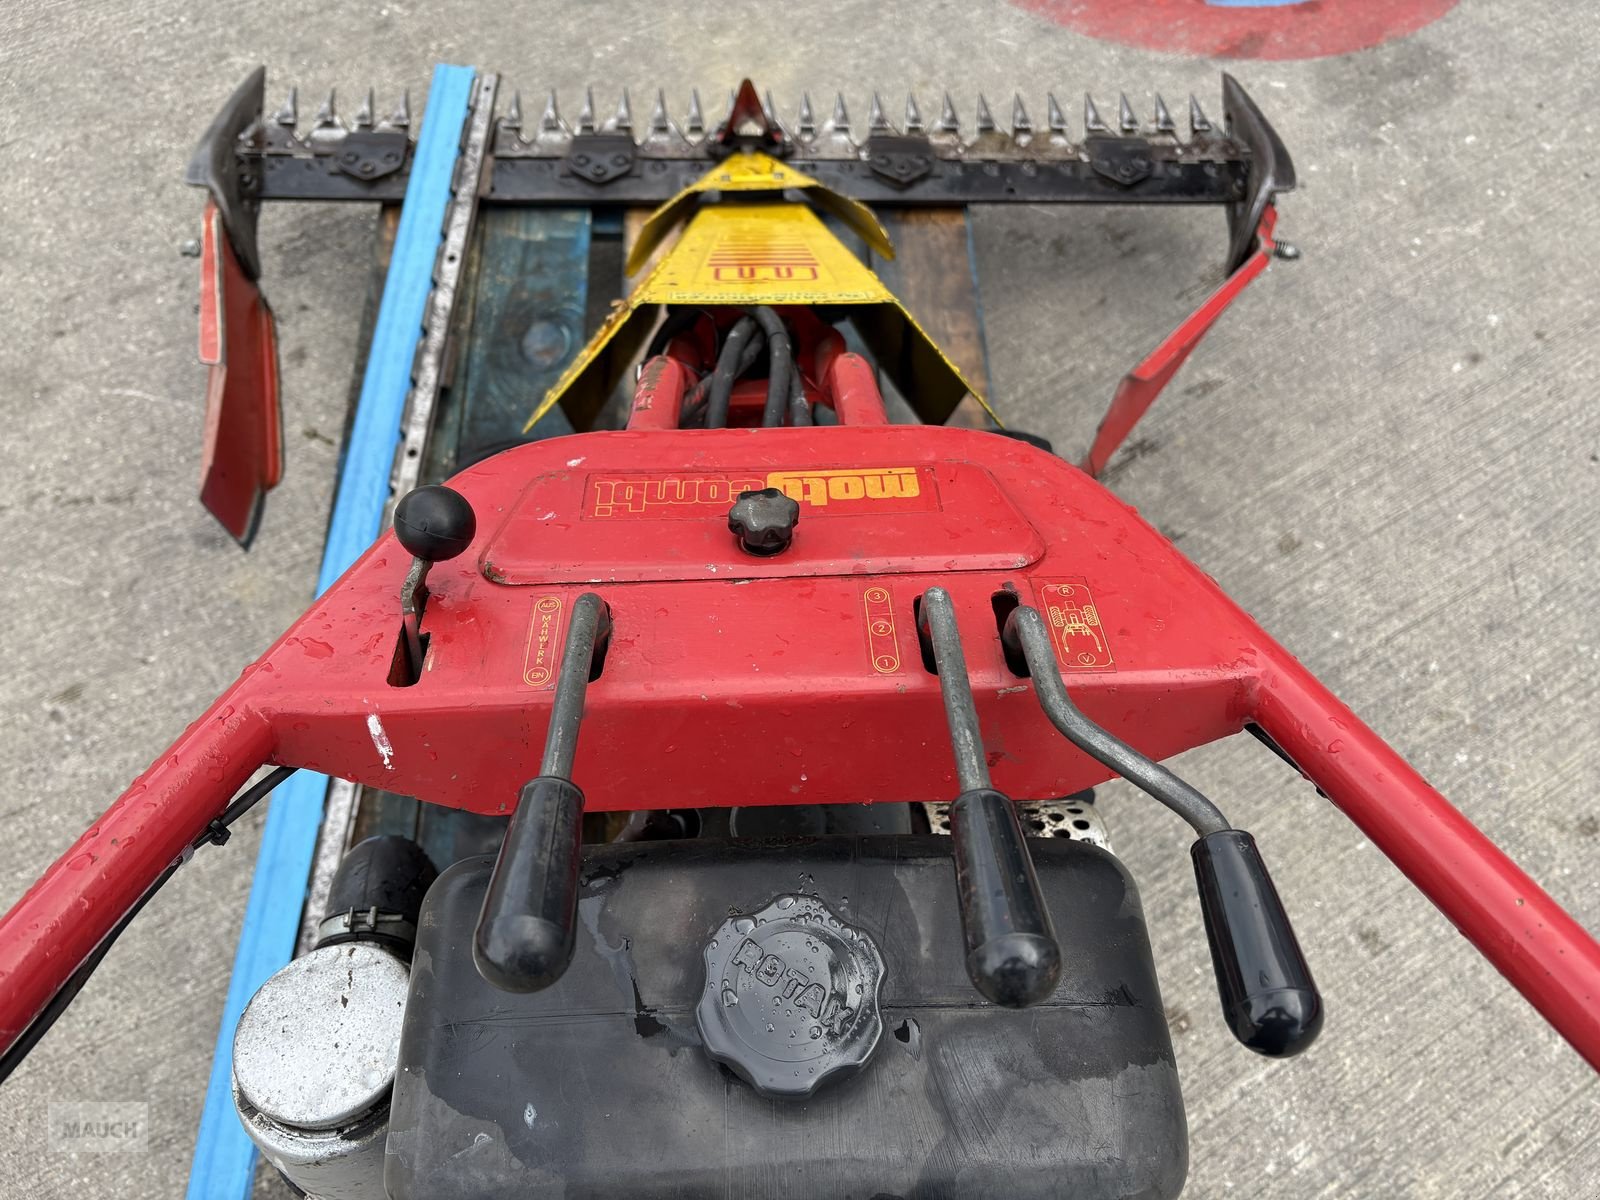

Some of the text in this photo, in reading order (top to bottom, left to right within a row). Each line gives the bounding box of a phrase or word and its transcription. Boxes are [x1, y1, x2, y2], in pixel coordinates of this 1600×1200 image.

[874, 592, 881, 600] 3
[878, 624, 886, 633] 2
[884, 659, 889, 667] 1
[1082, 655, 1090, 663] V
[531, 671, 544, 679] EIN
[732, 938, 854, 1036] ROTAX
